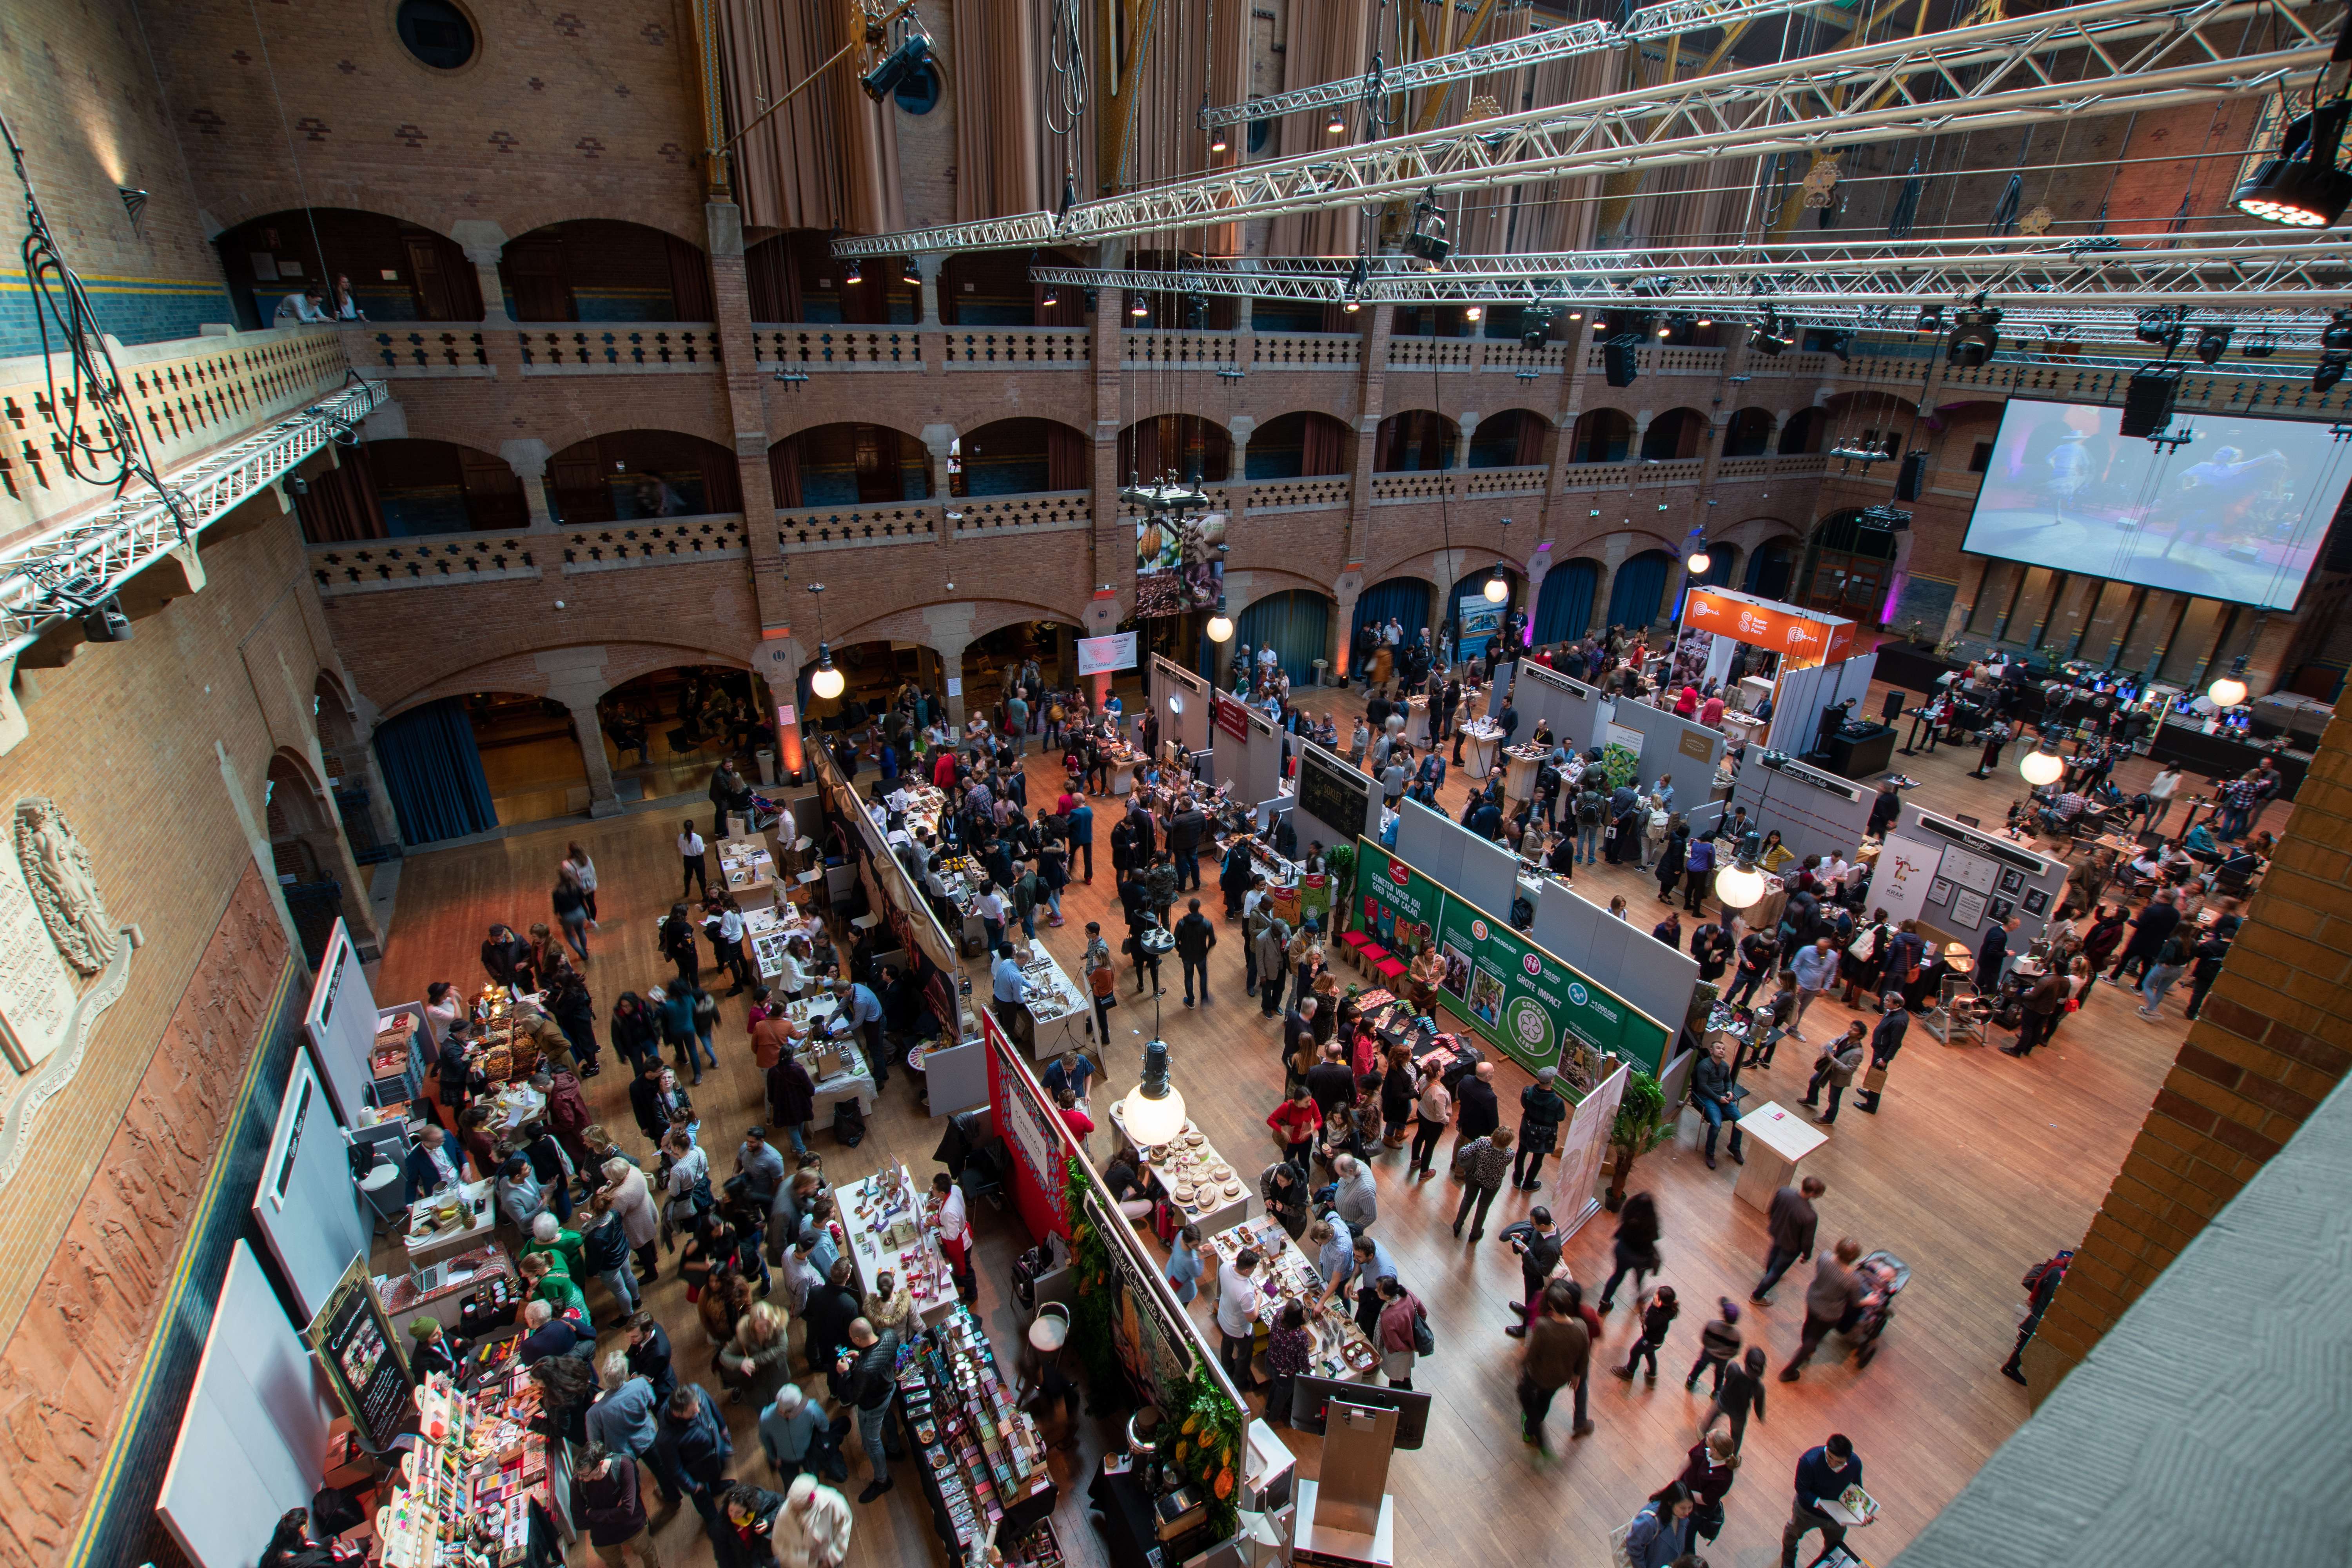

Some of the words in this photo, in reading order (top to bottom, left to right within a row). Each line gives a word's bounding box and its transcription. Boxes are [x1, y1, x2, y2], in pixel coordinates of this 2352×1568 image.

[1752, 622, 1766, 630] Foods
[1753, 617, 1768, 625] Super
[1684, 647, 1708, 659] Cocoa
[1686, 638, 1710, 651] Super
[1542, 675, 1559, 687] Chocolate
[1804, 774, 1827, 788] Chocolate
[1323, 784, 1342, 802] SOKLET
[1390, 868, 1399, 876] CÔTE
[1372, 873, 1394, 892] GENIETEN
[1396, 887, 1409, 902] VOOR
[1886, 888, 1904, 899] KRAK
[1372, 882, 1384, 895] GOED
[1386, 890, 1399, 905] VOOR
[1401, 901, 1418, 918] CACAO.
[1490, 933, 1517, 954] $400.000.000
[1543, 968, 1560, 983] 200.000
[1516, 973, 1536, 992] GROTE
[1537, 987, 1562, 1009] IMPACT
[8, 1005, 19, 1021] DIE
[19, 985, 36, 1007] GOED
[16, 986, 47, 1026] OFFERDEN
[1522, 1001, 1546, 1022] COCOA
[46, 1009, 63, 1037] RECHT
[1518, 1035, 1535, 1051] LIFE
[1015, 1110, 1042, 1157] CONEXIÓN
[1100, 1222, 1157, 1320] Cacaotales/Chocolate
[1158, 1316, 1171, 1341] Tree
